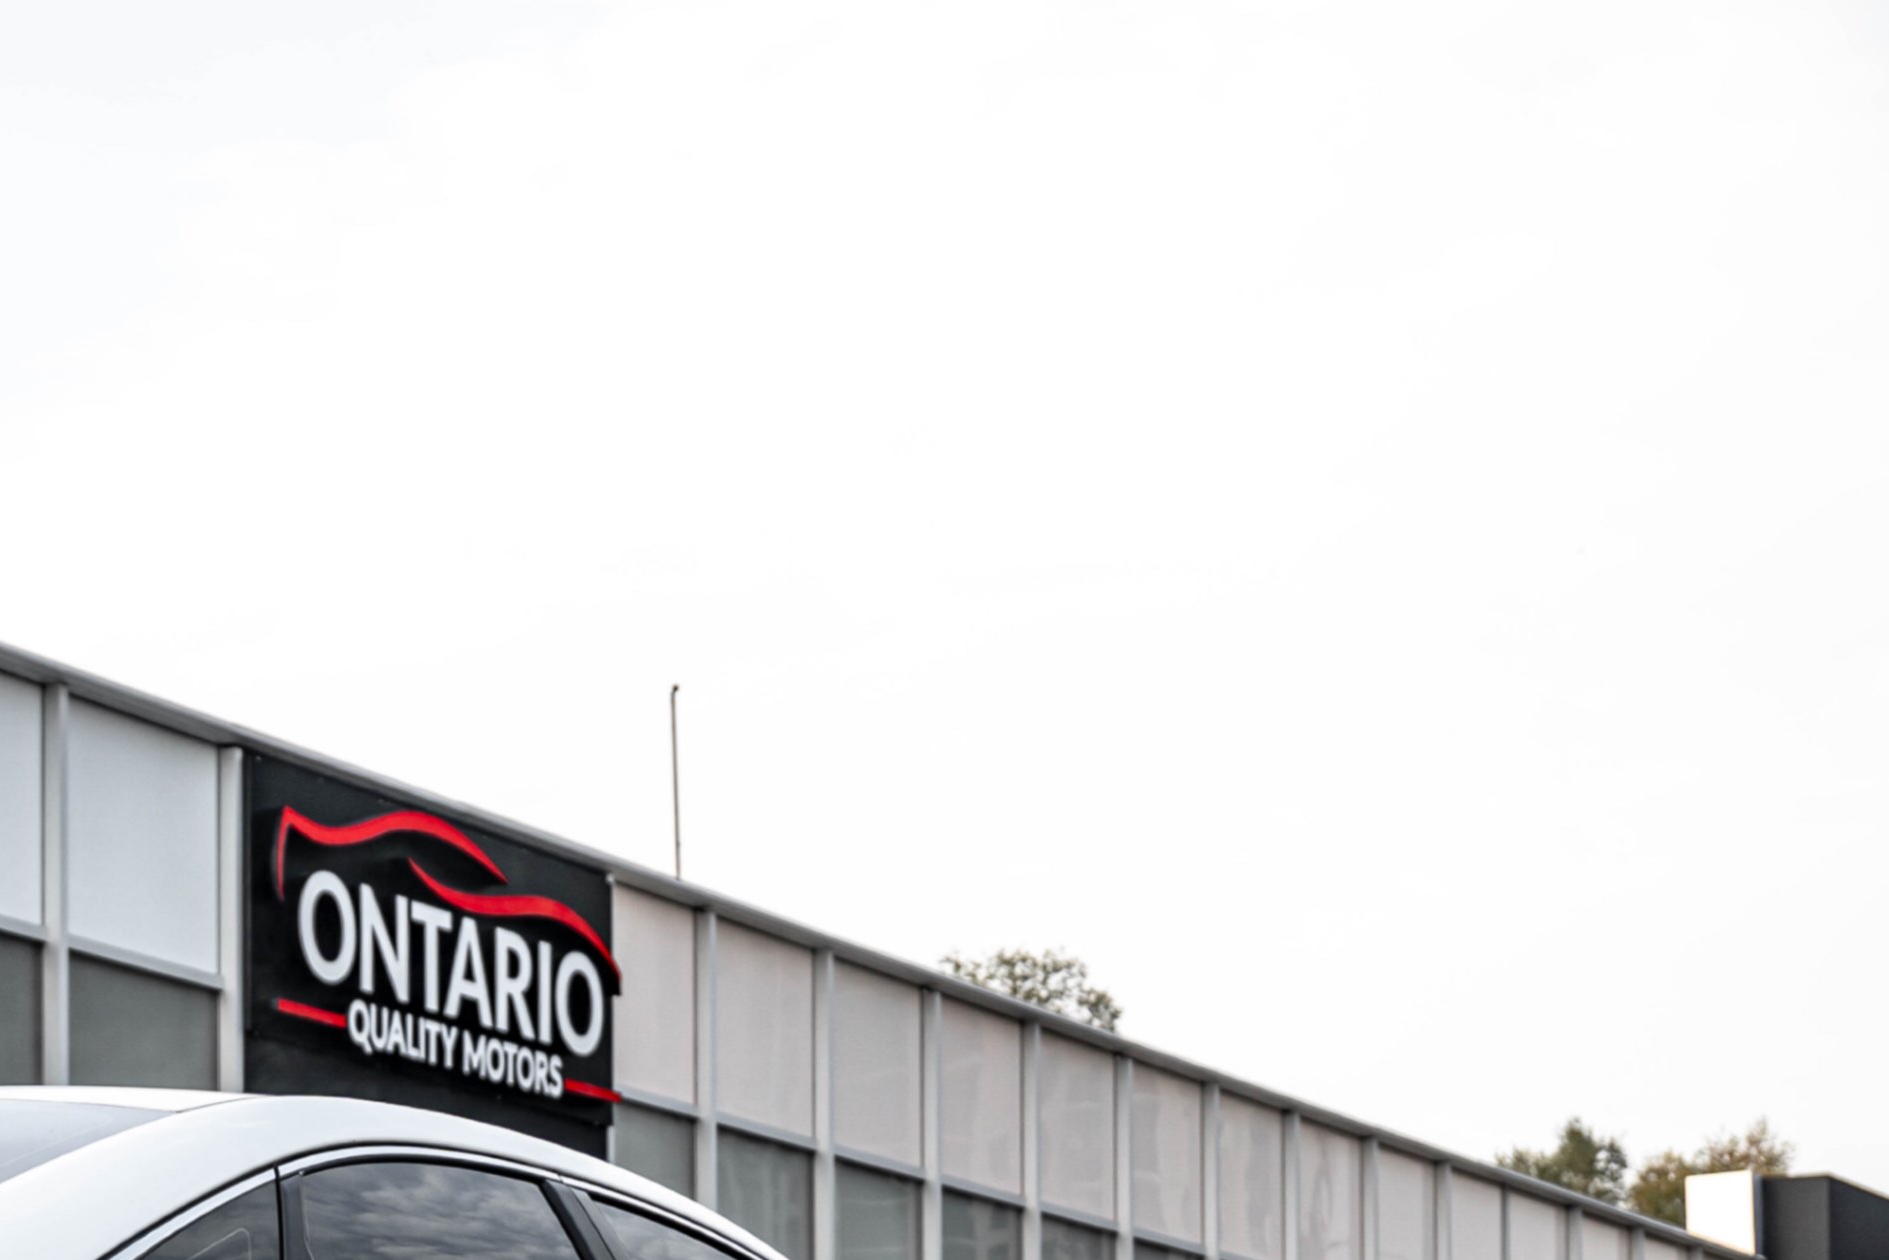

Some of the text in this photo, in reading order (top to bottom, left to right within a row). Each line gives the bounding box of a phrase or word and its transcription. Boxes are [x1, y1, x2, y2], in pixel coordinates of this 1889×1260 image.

[298, 869, 605, 1057] ONTARIO
[347, 998, 564, 1099] QUALITY MOTORS
